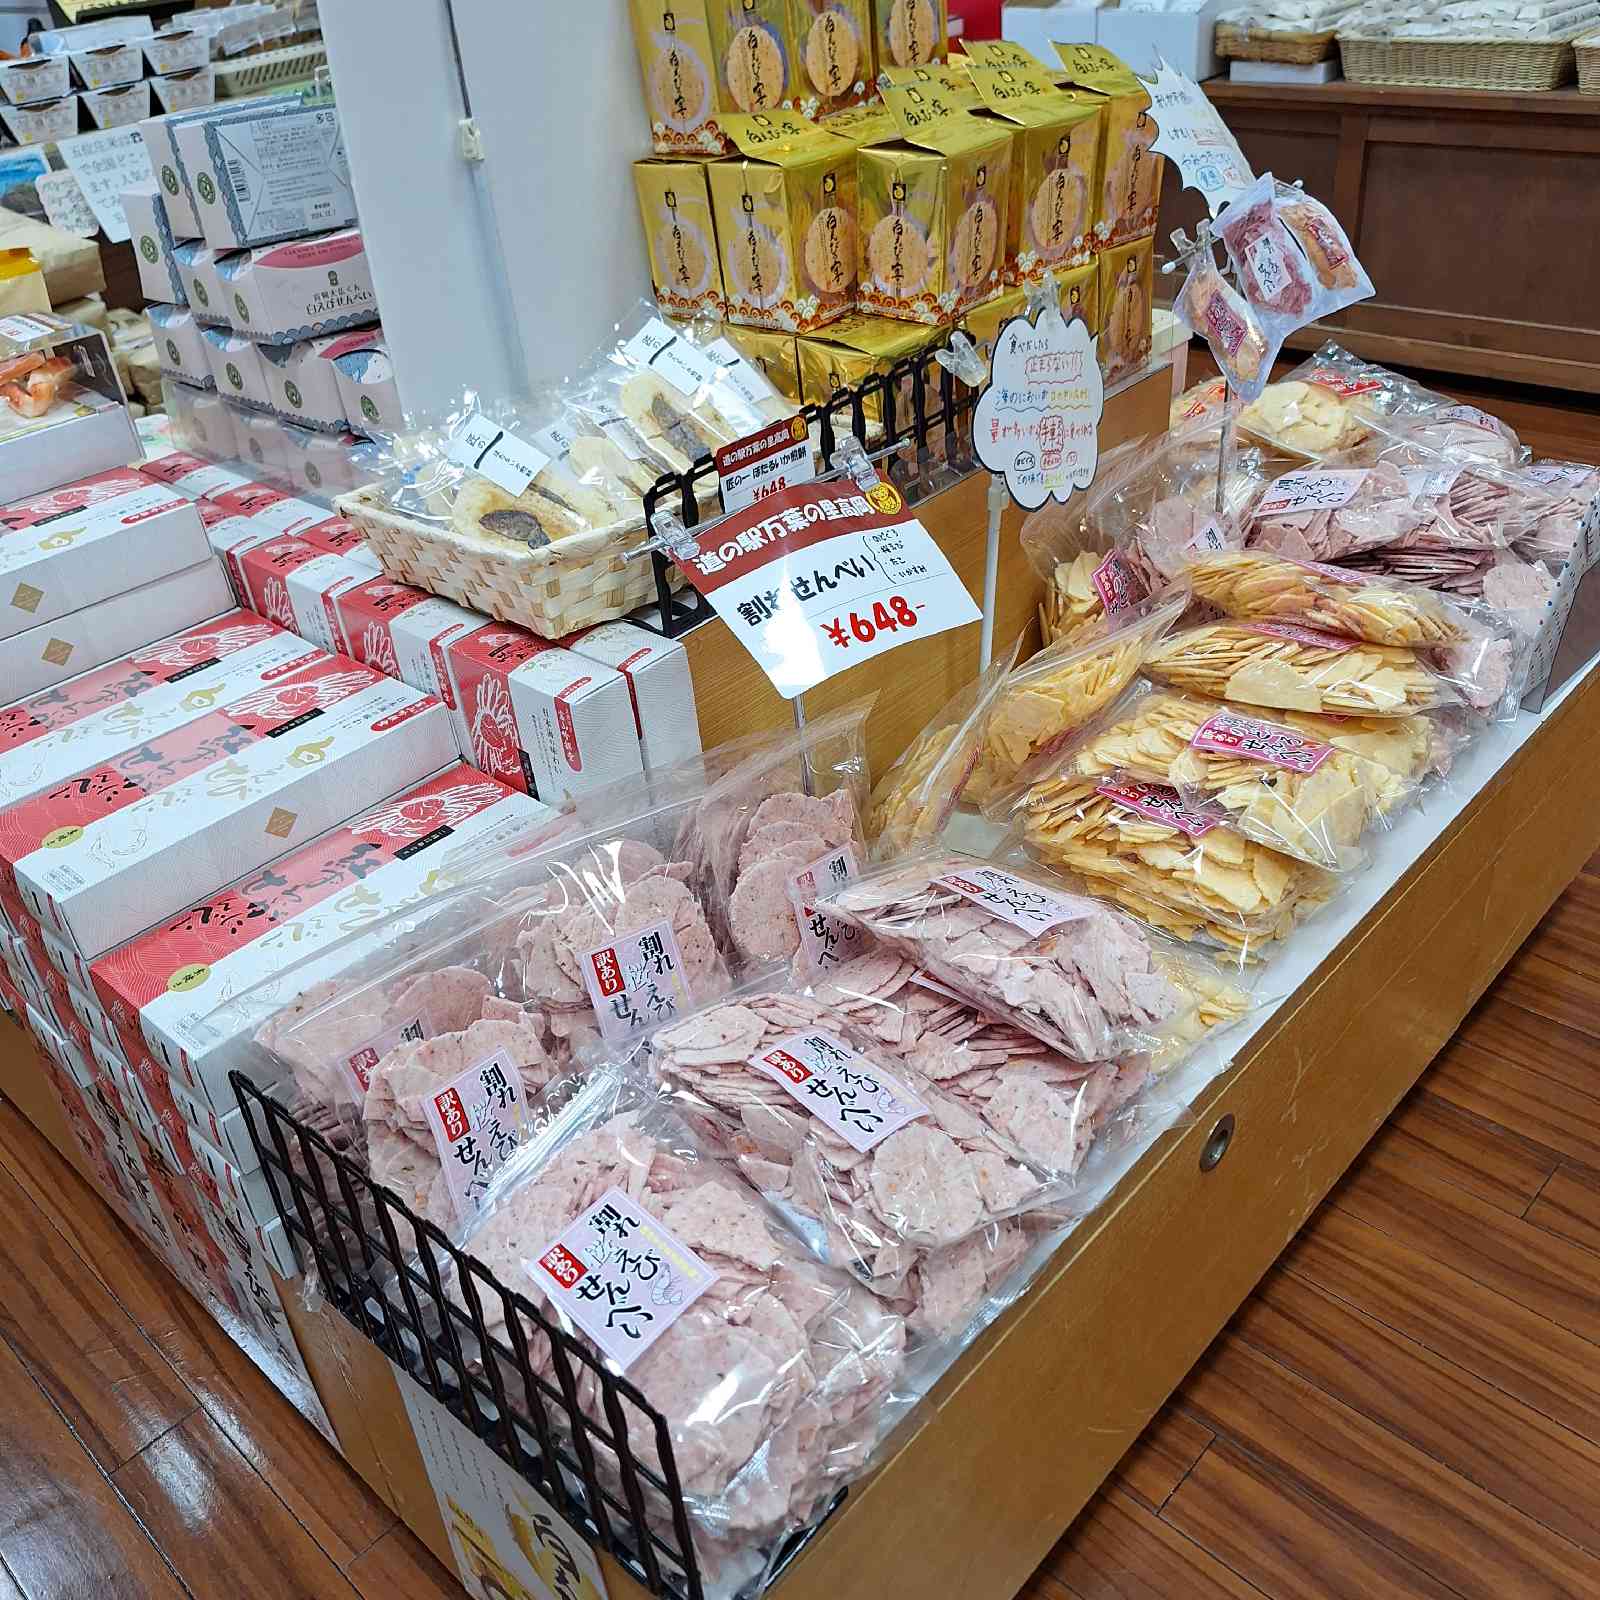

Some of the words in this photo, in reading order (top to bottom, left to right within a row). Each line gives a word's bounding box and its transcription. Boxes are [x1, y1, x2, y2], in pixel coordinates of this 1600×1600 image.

[695, 494, 876, 576] 道の駅万葉の里高岡
[979, 892, 1053, 922] せんべい
[595, 950, 620, 993] 訳あり
[637, 930, 676, 976] 割れ
[479, 1062, 519, 1109] 割れ
[767, 1052, 807, 1081] 訳あり
[836, 1064, 881, 1093] えび
[433, 1091, 464, 1139] 訳あり
[806, 1077, 885, 1134] せんべい
[588, 1203, 641, 1240] 割れ
[545, 1246, 583, 1285] 訳あり
[612, 1247, 663, 1282] えび
[575, 1271, 655, 1340] せんべい
